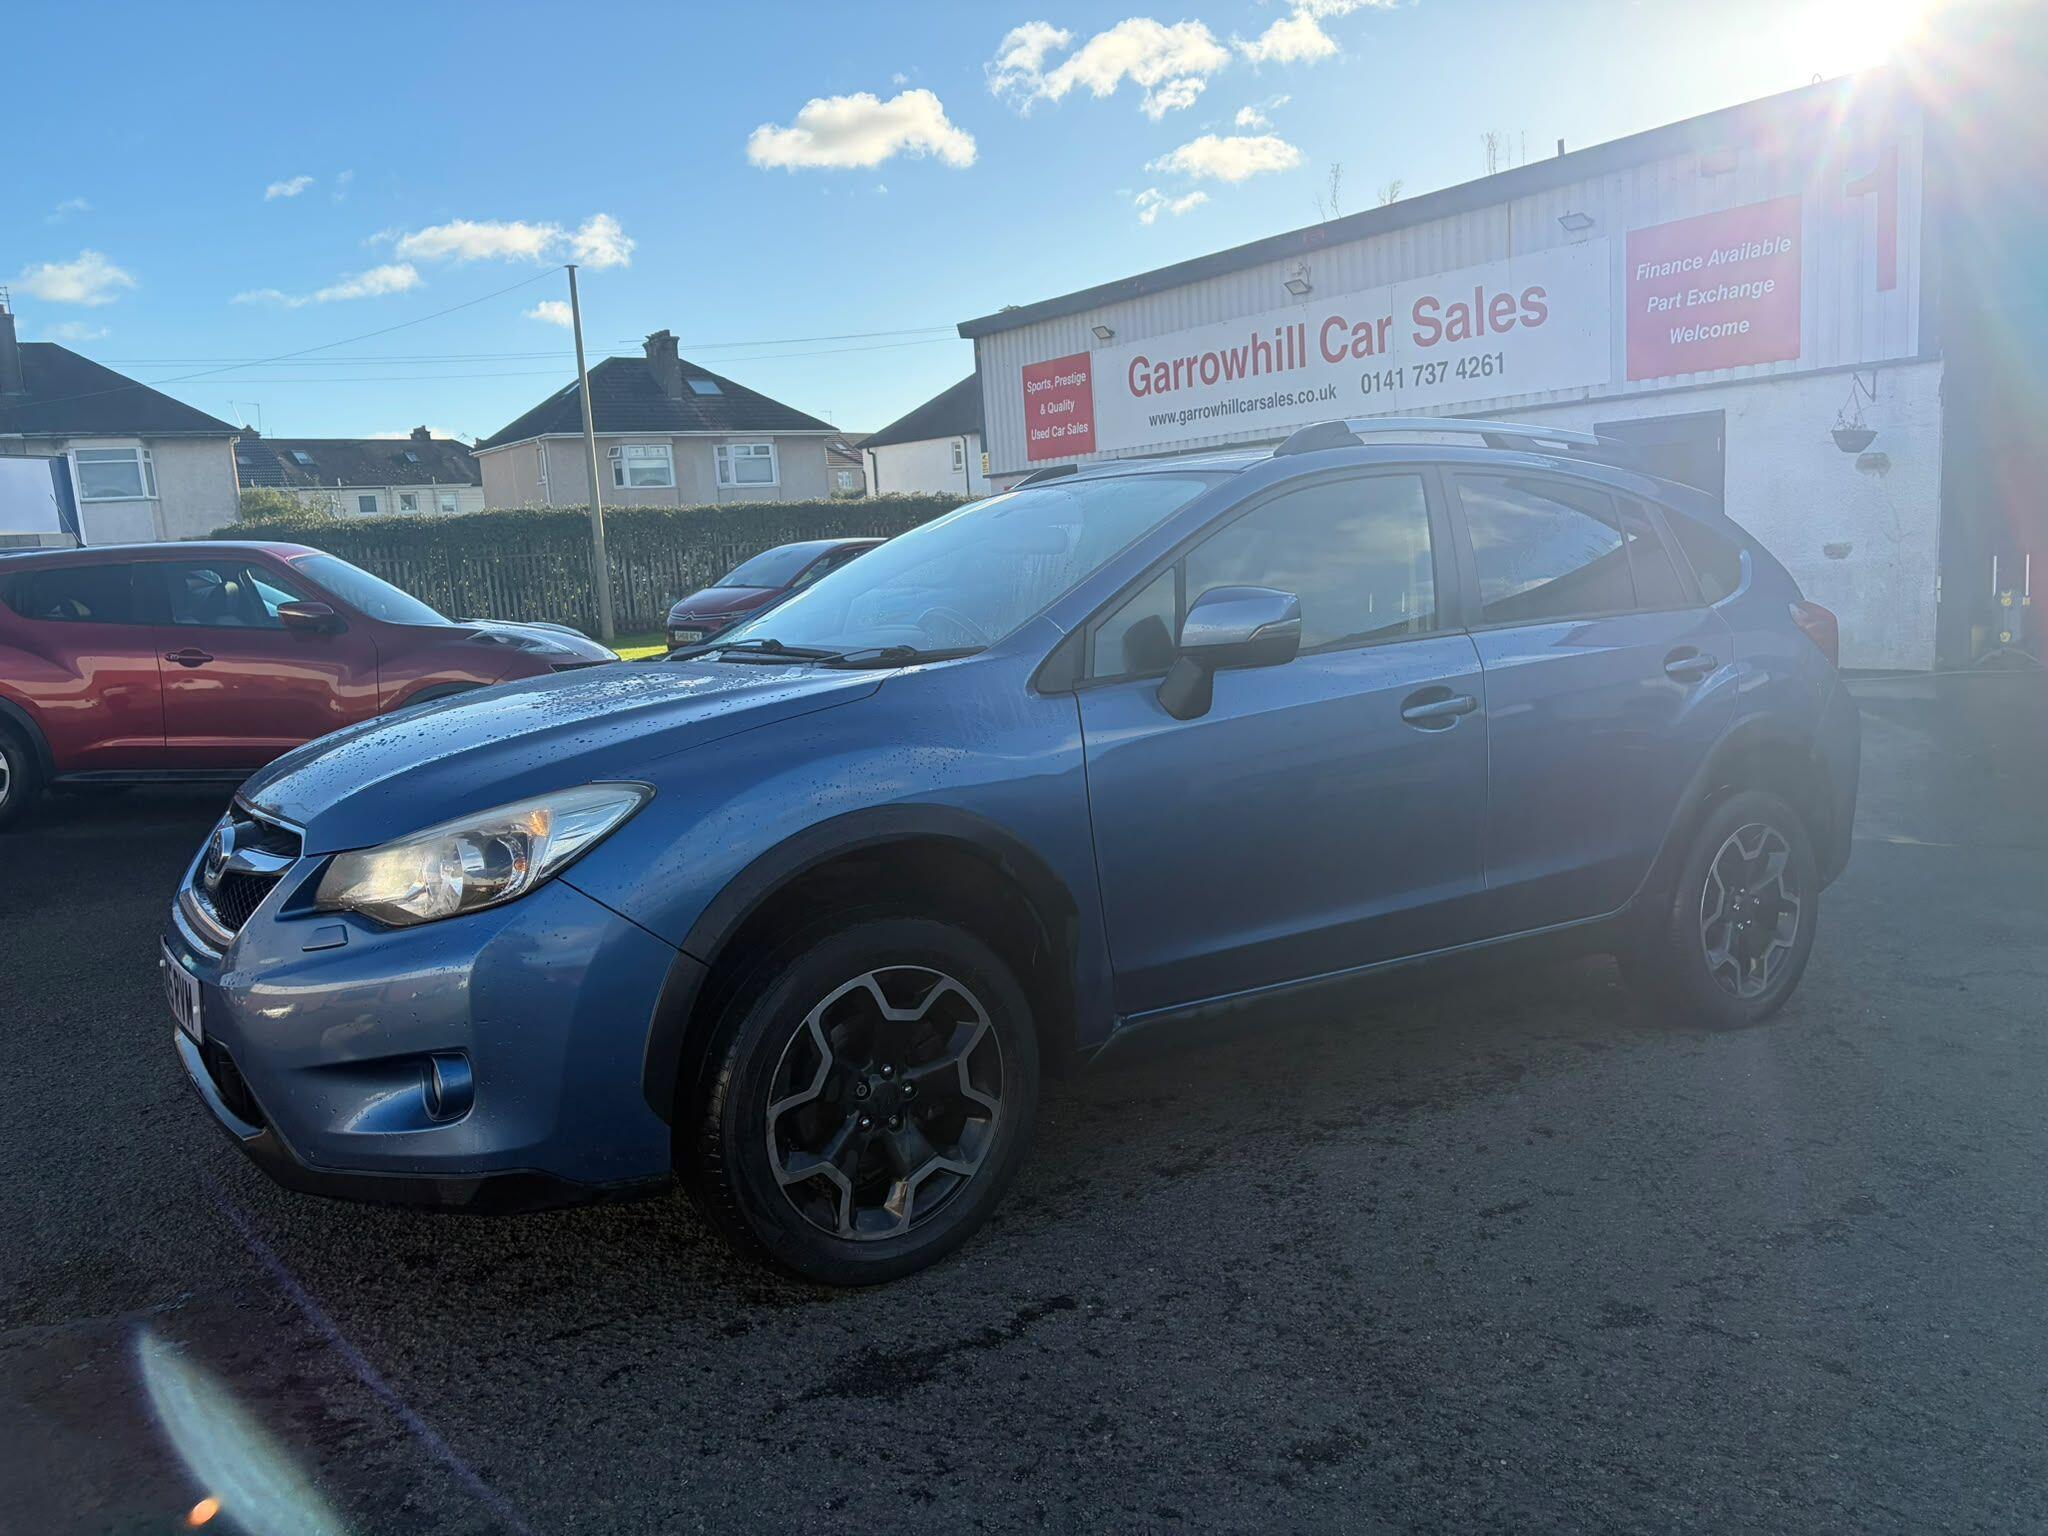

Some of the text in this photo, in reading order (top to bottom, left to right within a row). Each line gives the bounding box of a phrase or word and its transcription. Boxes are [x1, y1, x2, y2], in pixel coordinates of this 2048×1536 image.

[1636, 236, 1792, 281] Finance Available
[1647, 278, 1775, 313] Part Exchange
[1128, 285, 1548, 398] Garrowhill Car Sales
[1669, 319, 1750, 344] Welcome
[1026, 371, 1087, 394] Sports, Prestige
[1360, 351, 1504, 395] 0141 737 4261
[1040, 400, 1075, 415] & Quality
[1149, 383, 1337, 427] www.garrowhillcarsales.co.uk
[1031, 422, 1089, 441] Used Car Sales
